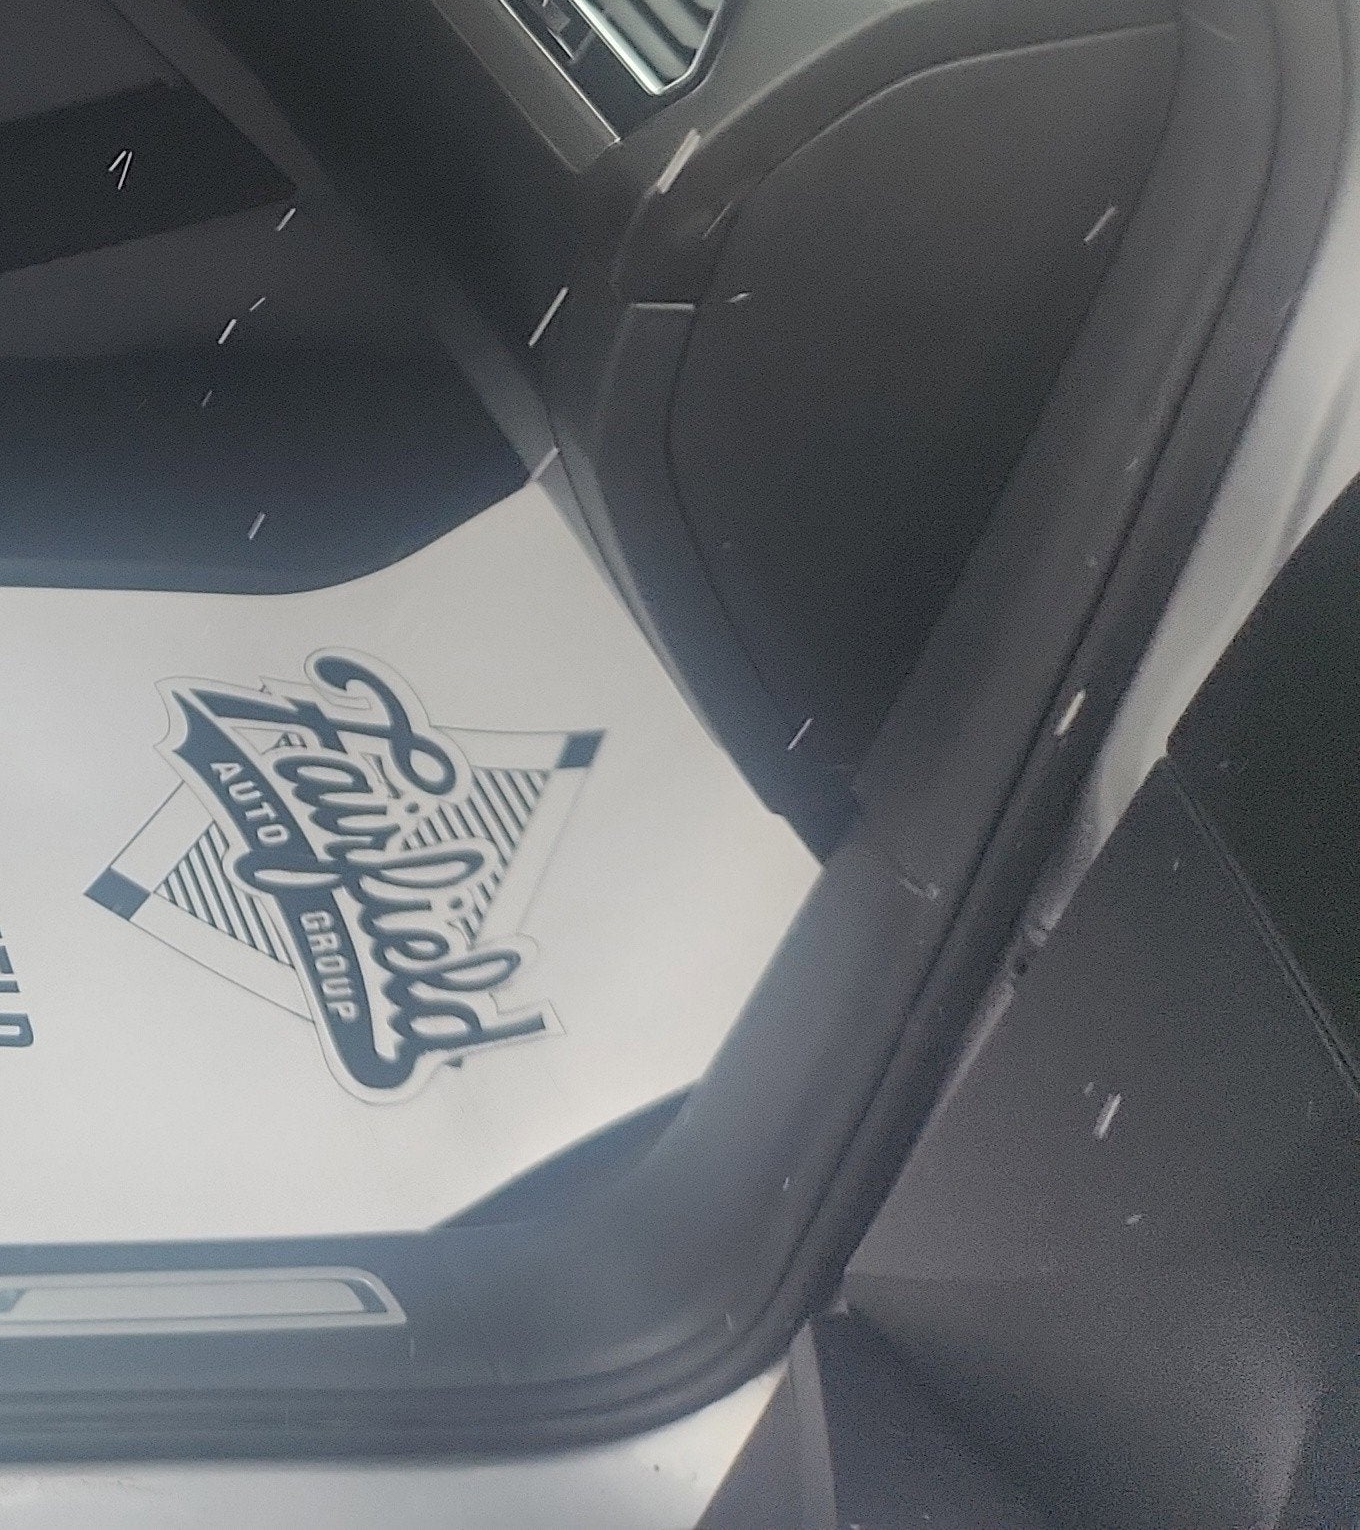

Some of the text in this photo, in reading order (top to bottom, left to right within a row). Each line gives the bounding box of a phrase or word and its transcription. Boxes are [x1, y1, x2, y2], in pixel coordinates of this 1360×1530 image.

[178, 655, 547, 1086] Fairfield
[210, 761, 359, 1022] AUTO GROUP
